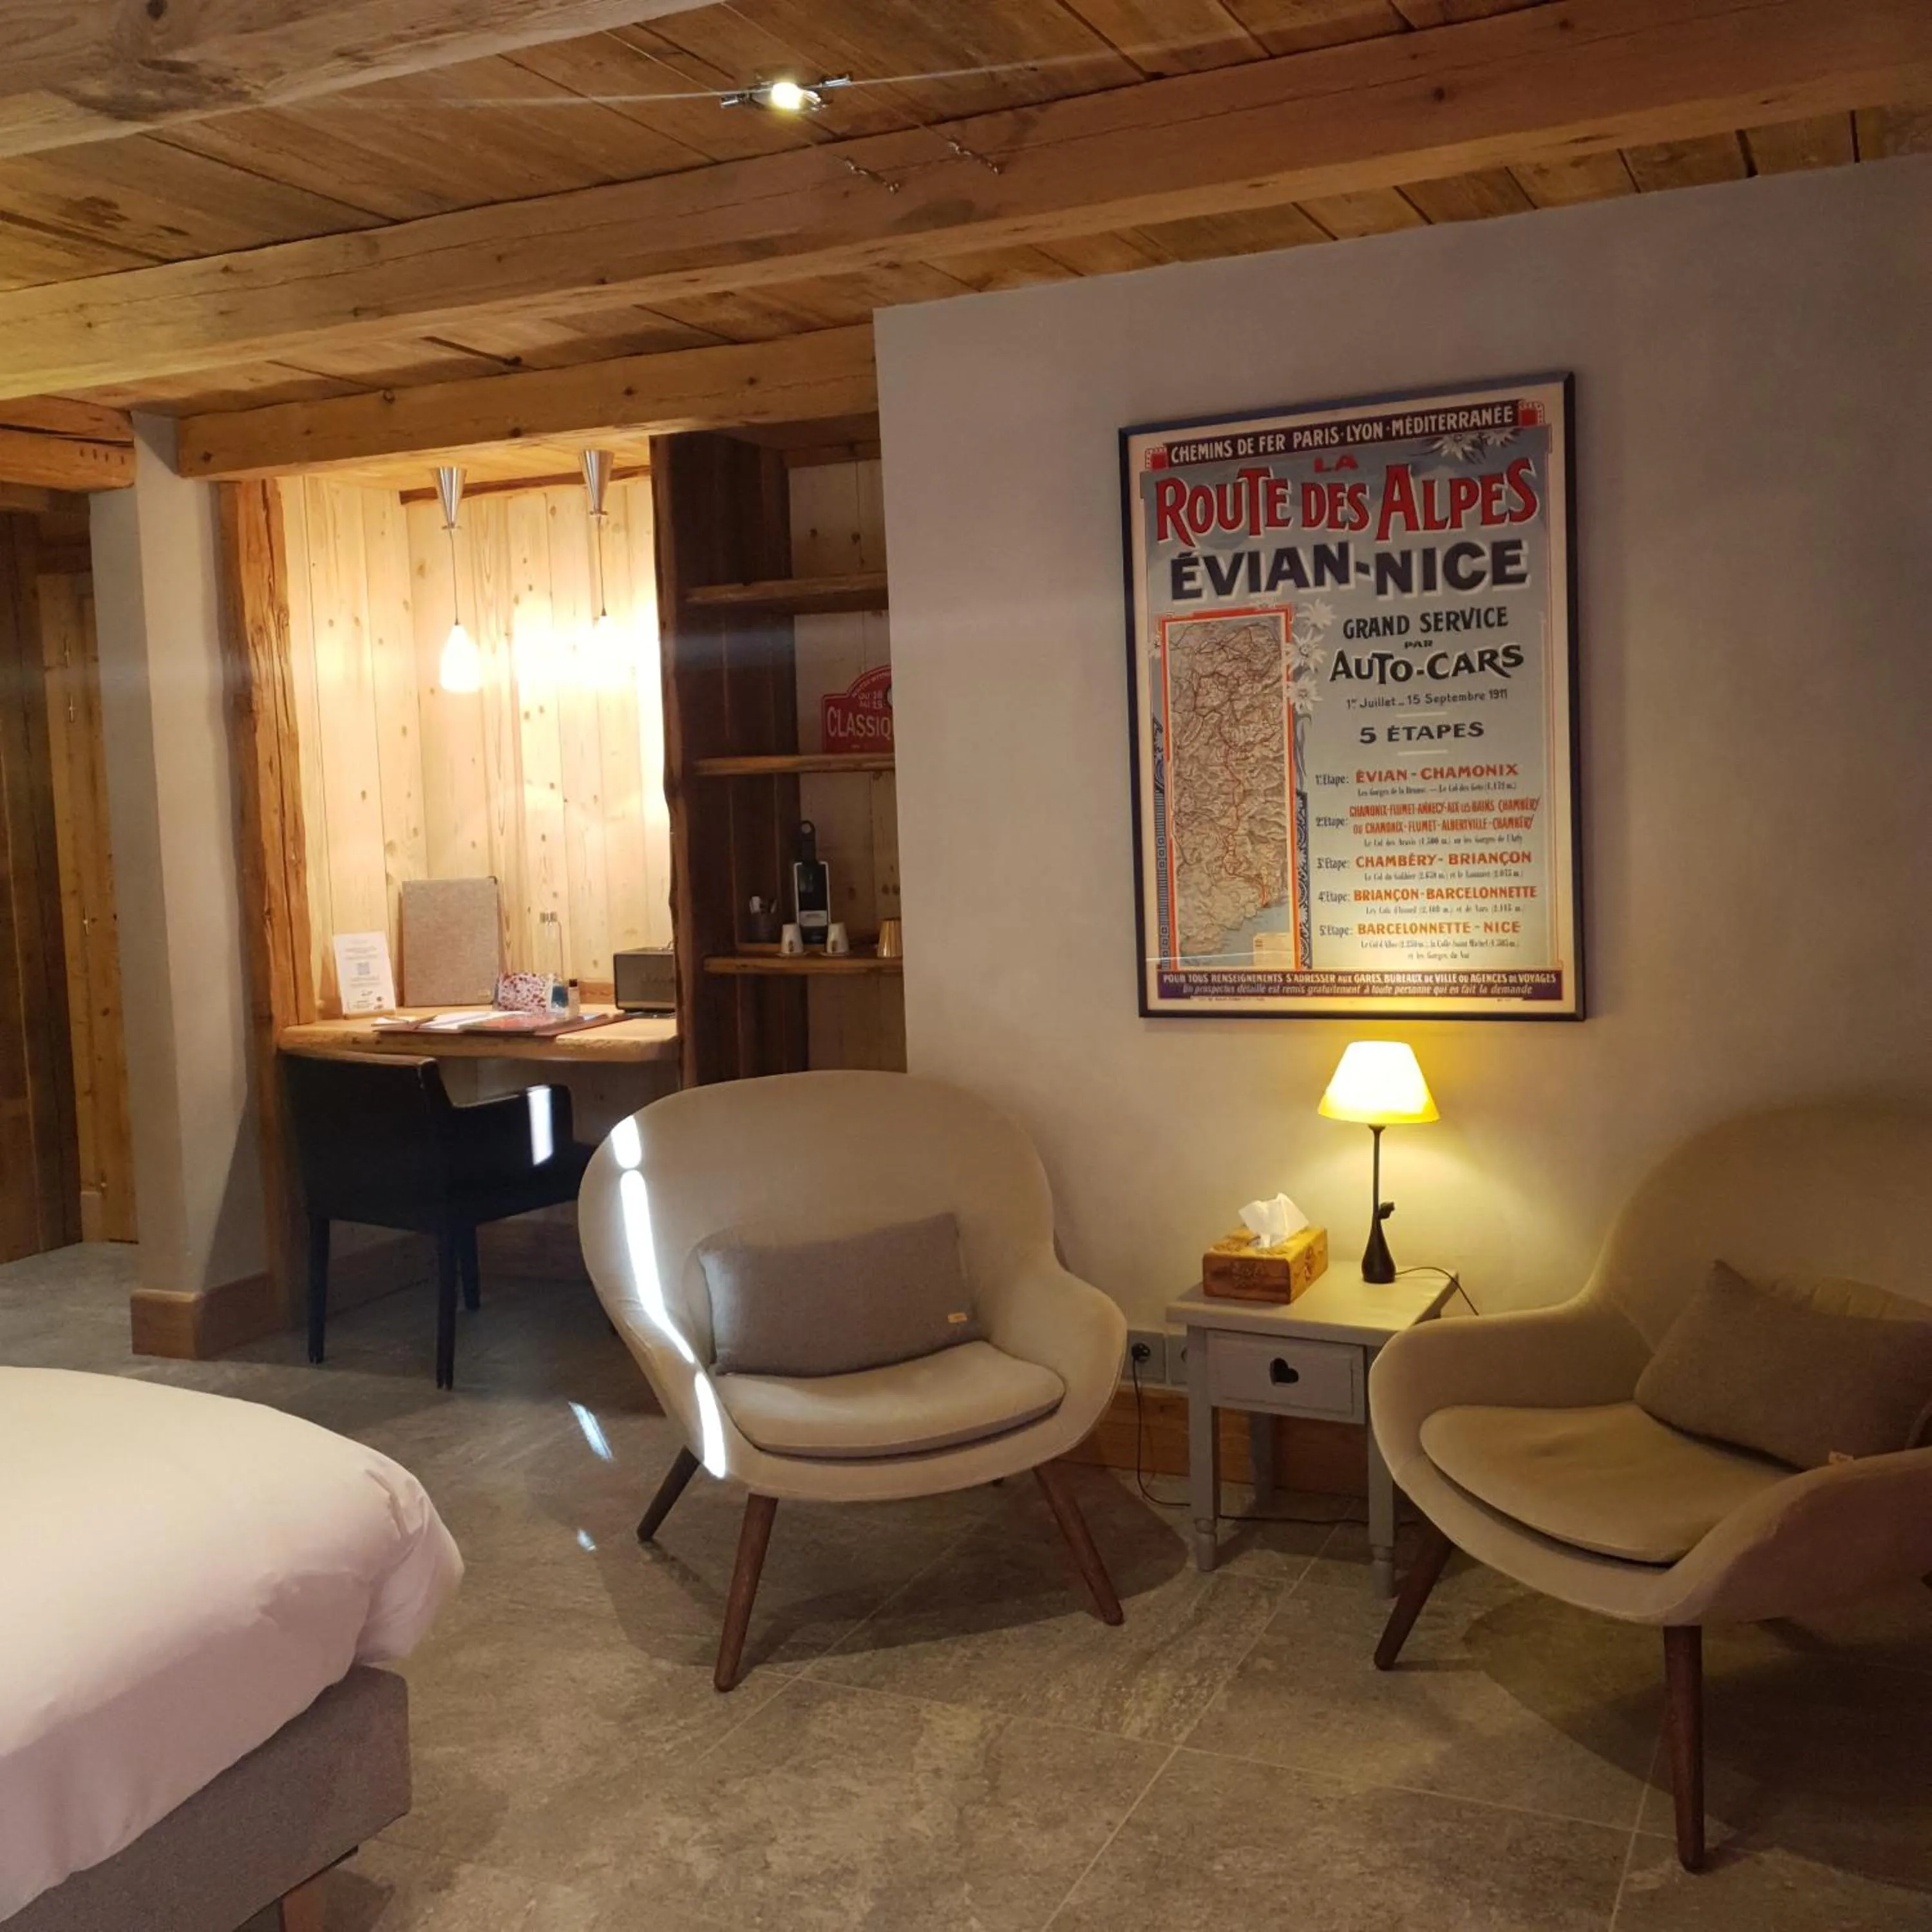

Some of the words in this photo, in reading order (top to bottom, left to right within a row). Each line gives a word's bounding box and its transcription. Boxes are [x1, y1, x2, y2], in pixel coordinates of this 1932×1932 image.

[1171, 440, 1233, 464] CHEMINS
[1237, 437, 1254, 455] DE
[1259, 433, 1285, 452] FER
[1314, 455, 1359, 473] LA
[1155, 467, 1293, 548] ROUTE
[1301, 482, 1370, 532] DES
[1376, 457, 1539, 542] ALPES
[1343, 614, 1410, 639] GRAND
[1419, 606, 1509, 632] SERVICE
[1404, 639, 1434, 649] PAR
[1329, 645, 1524, 685] AUTO-CARS
[1359, 696, 1396, 708] Juillet
[1407, 694, 1421, 706] 15
[1425, 690, 1486, 706] Septembre
[1488, 688, 1508, 701] 1911
[1359, 727, 1377, 744] 5
[1387, 721, 1484, 742] ÉTAPES
[1421, 764, 1519, 780] CHAMONIX
[1448, 851, 1532, 866] BRIANÇON
[1358, 922, 1472, 934] BARCELONNETTE
[1484, 921, 1521, 933] NICE
[1434, 973, 1457, 983] VILLE
[1518, 973, 1556, 983] VOYAGES
